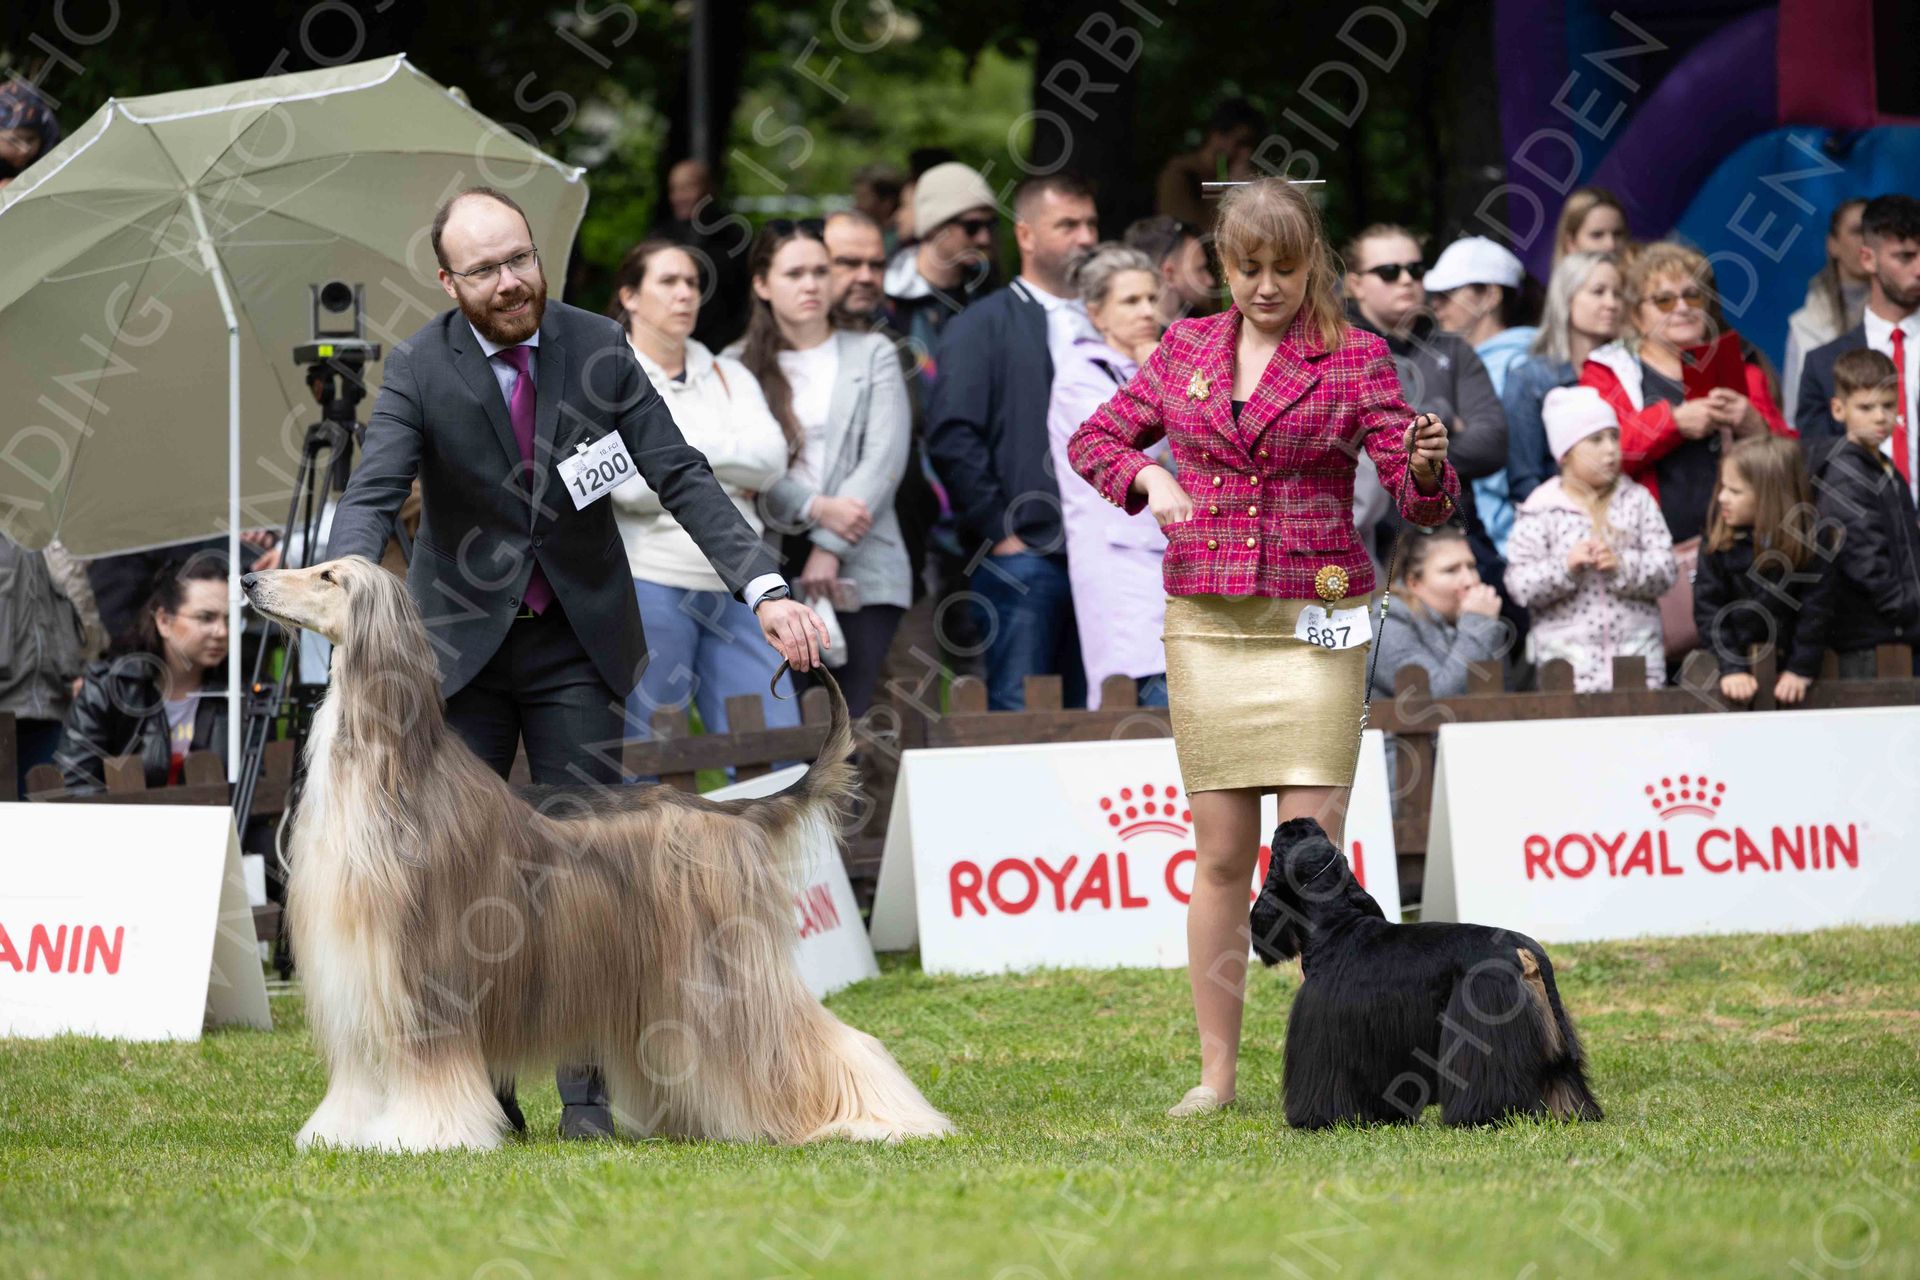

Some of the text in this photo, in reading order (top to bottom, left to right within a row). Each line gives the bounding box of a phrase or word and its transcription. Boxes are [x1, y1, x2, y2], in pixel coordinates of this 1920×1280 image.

[573, 452, 629, 497] 1200
[1307, 626, 1350, 649] 887
[1524, 823, 1860, 880] ROYAL CANIN
[949, 852, 1149, 918] ROYAL
